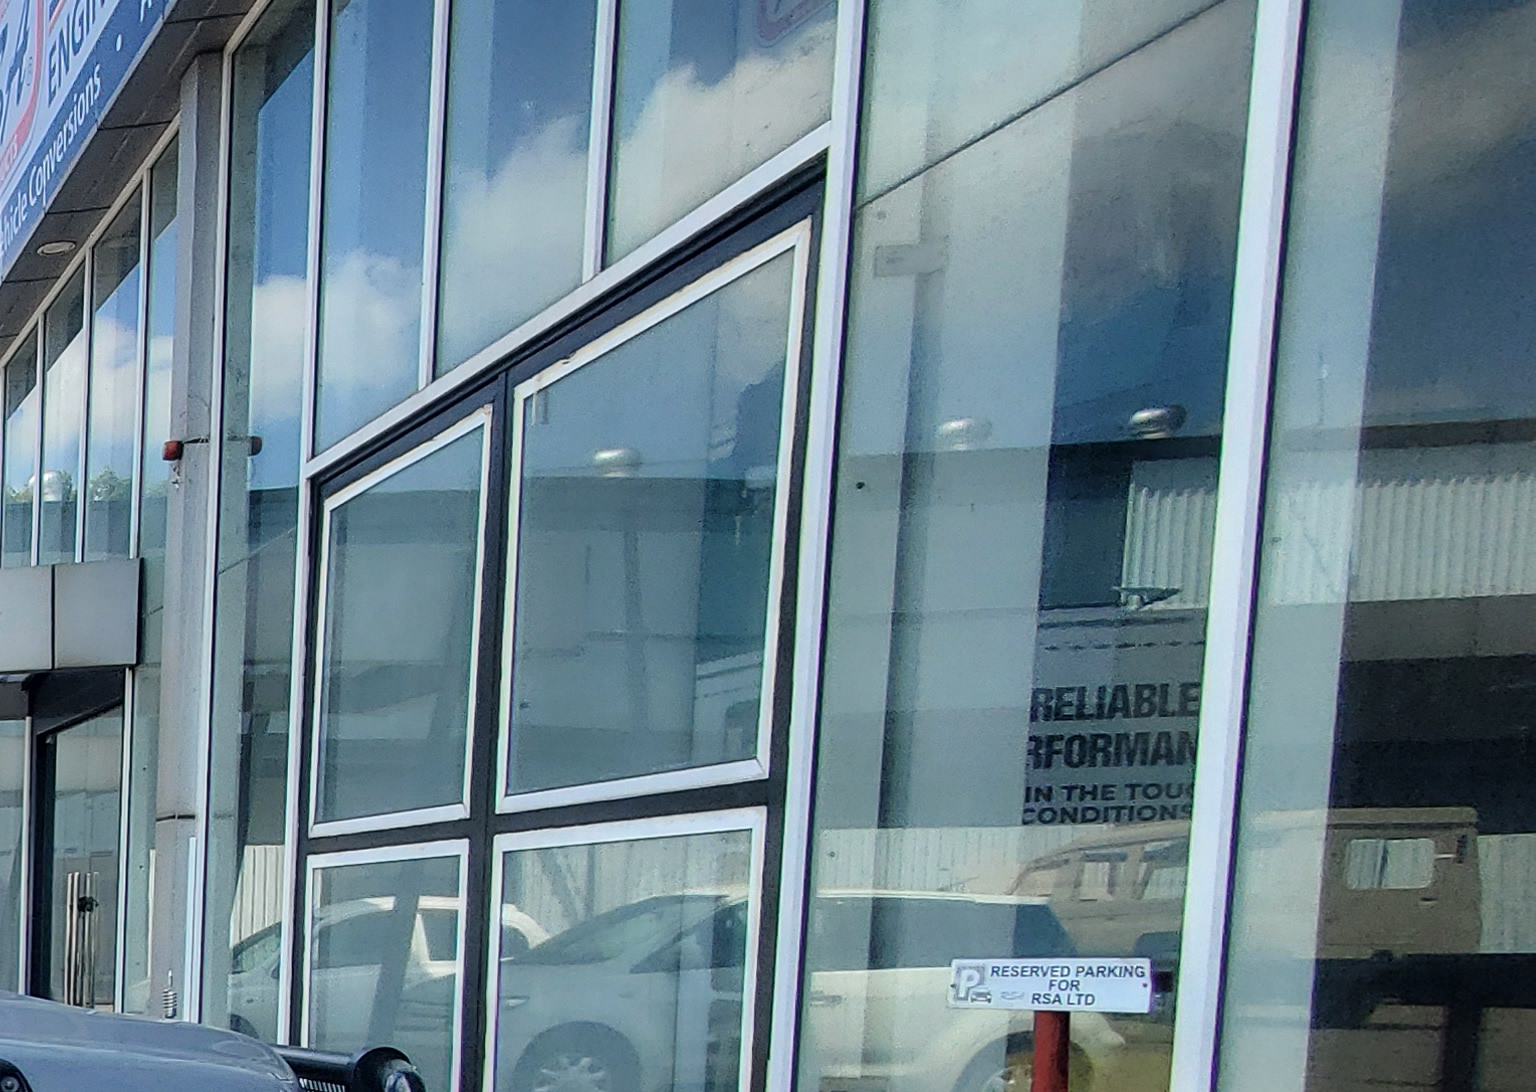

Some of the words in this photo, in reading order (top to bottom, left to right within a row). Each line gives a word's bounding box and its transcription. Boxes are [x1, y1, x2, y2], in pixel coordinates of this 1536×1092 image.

[29, 63, 101, 206] Conversions
[1029, 682, 1201, 722] RELIABLE
[1024, 785, 1053, 803] IN
[1060, 784, 1118, 802] THE
[990, 966, 1070, 977] RESERVED
[1075, 966, 1145, 978] PARKING
[1048, 980, 1080, 991] FOR
[1031, 993, 1062, 1005] RSA
[1067, 994, 1095, 1006] LTD
